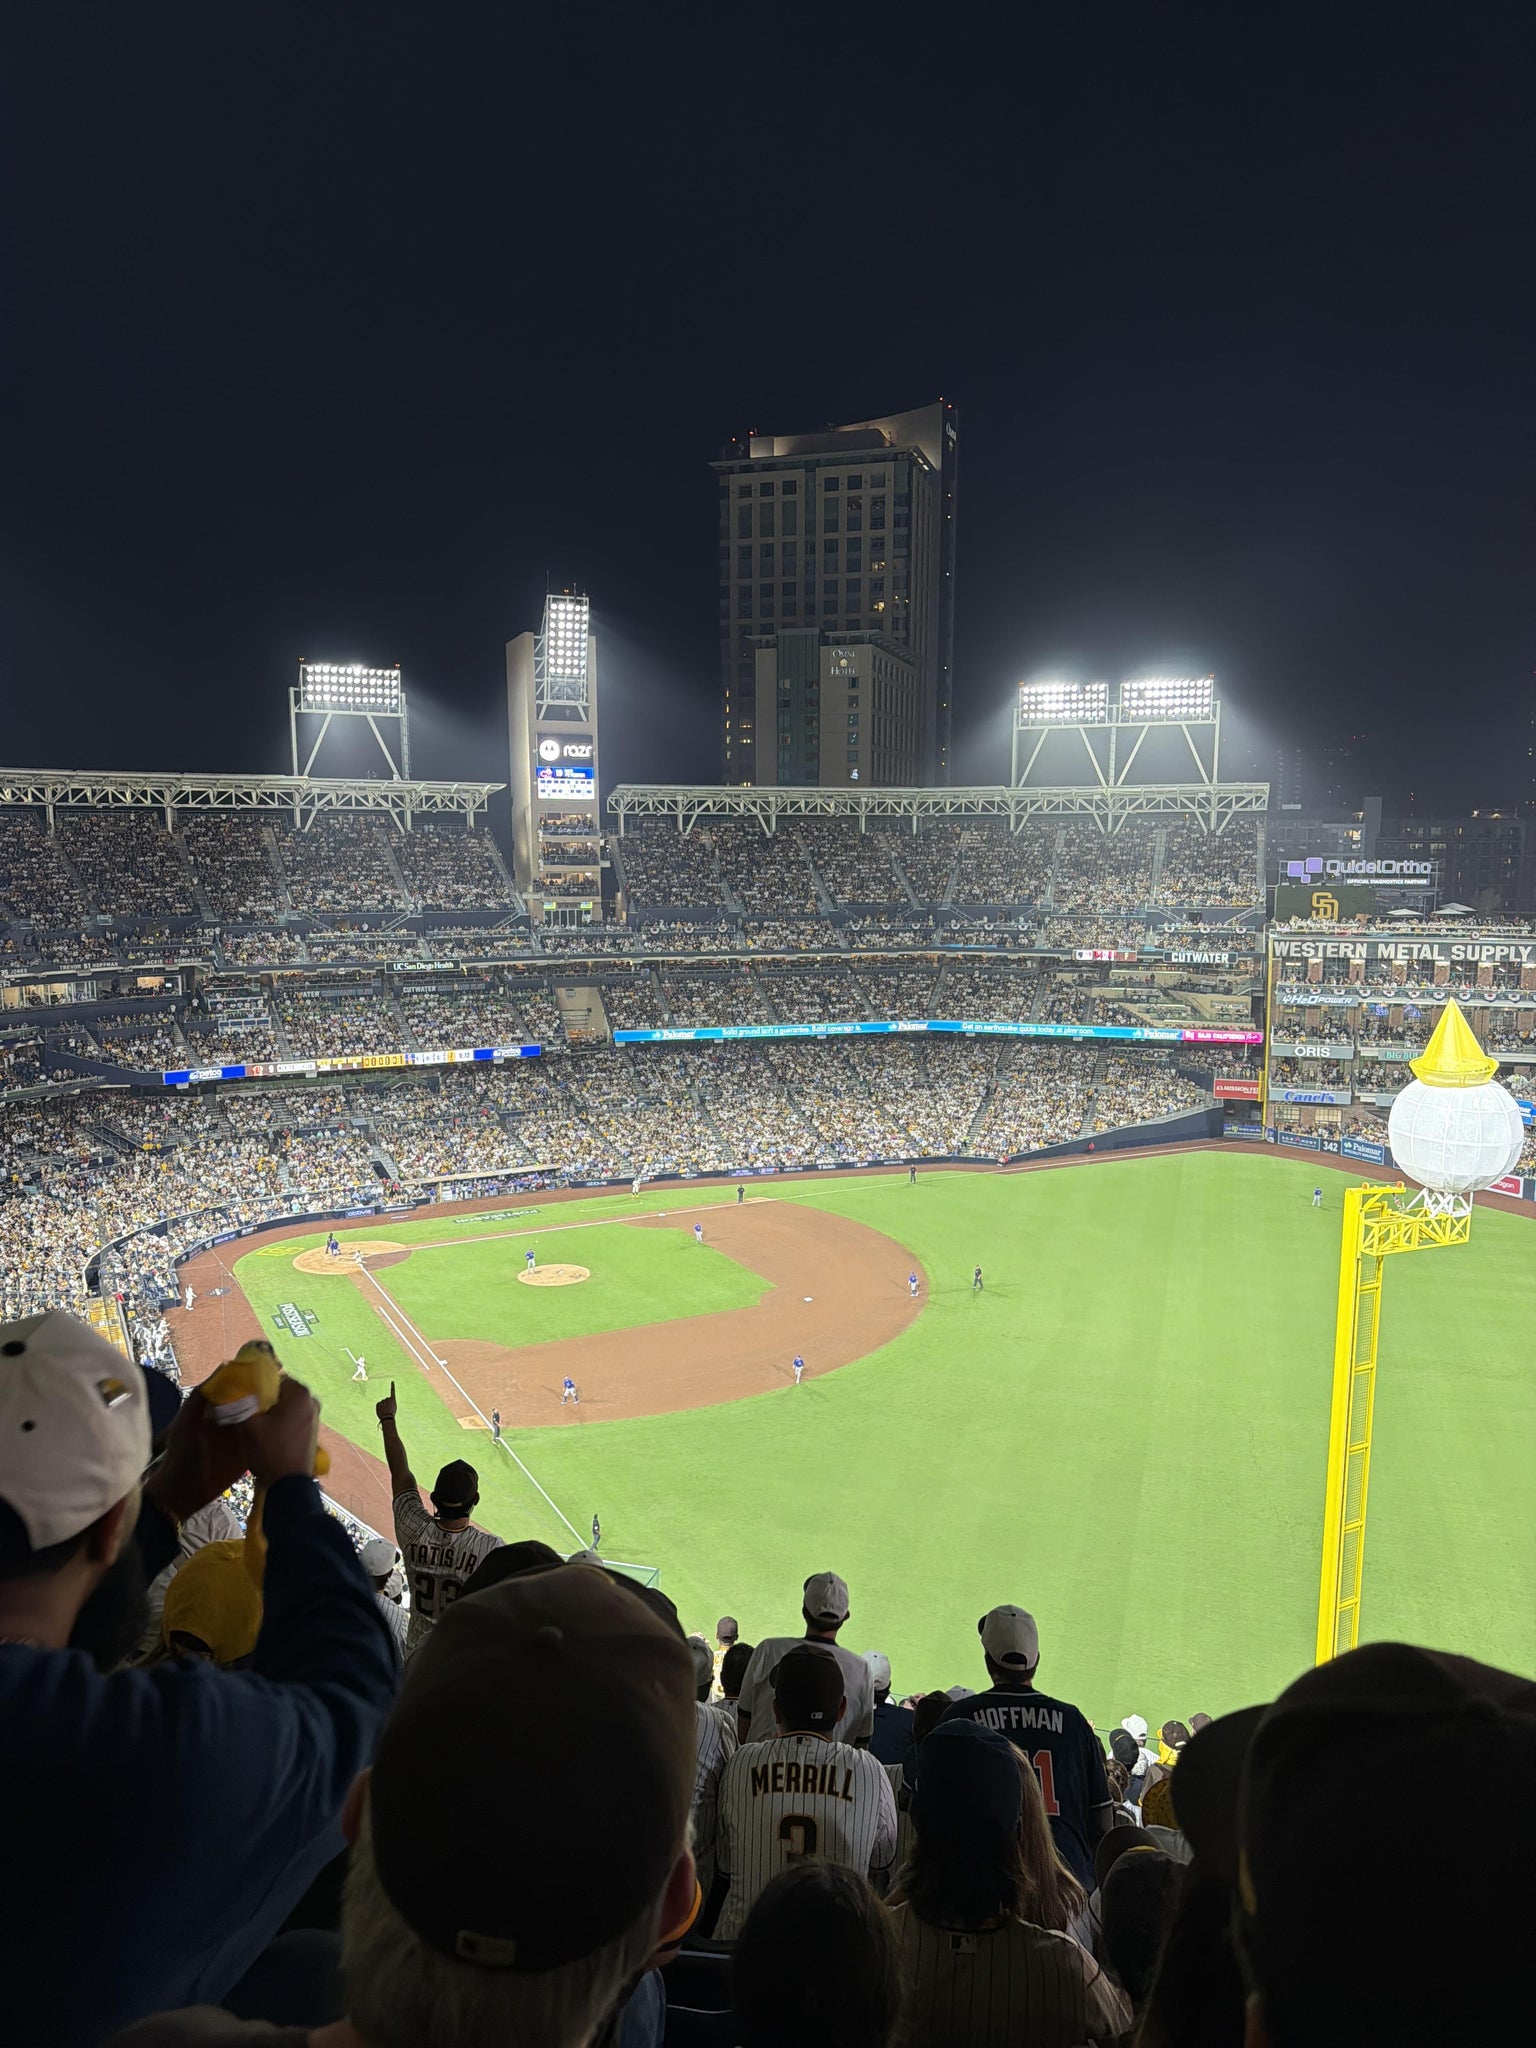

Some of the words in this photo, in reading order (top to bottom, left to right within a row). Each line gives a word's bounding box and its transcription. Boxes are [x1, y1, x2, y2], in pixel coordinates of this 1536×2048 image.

[563, 745, 592, 757] razr
[1326, 859, 1432, 876] QuidelOrtho
[1172, 952, 1229, 962] CUTWATER
[1274, 941, 1367, 959] WESTERN
[1378, 944, 1445, 960] METAL
[1451, 944, 1533, 962] SUPPLY
[417, 962, 434, 970] Diego
[1144, 1030, 1177, 1039] Palomar
[1295, 1047, 1331, 1057] ORIS
[1323, 1142, 1338, 1152] 342
[1353, 1142, 1382, 1156] Palomar
[409, 1544, 454, 1567] TATIS
[973, 1706, 1063, 1734] HOFFMAN
[751, 1762, 853, 1802] MERRILL
